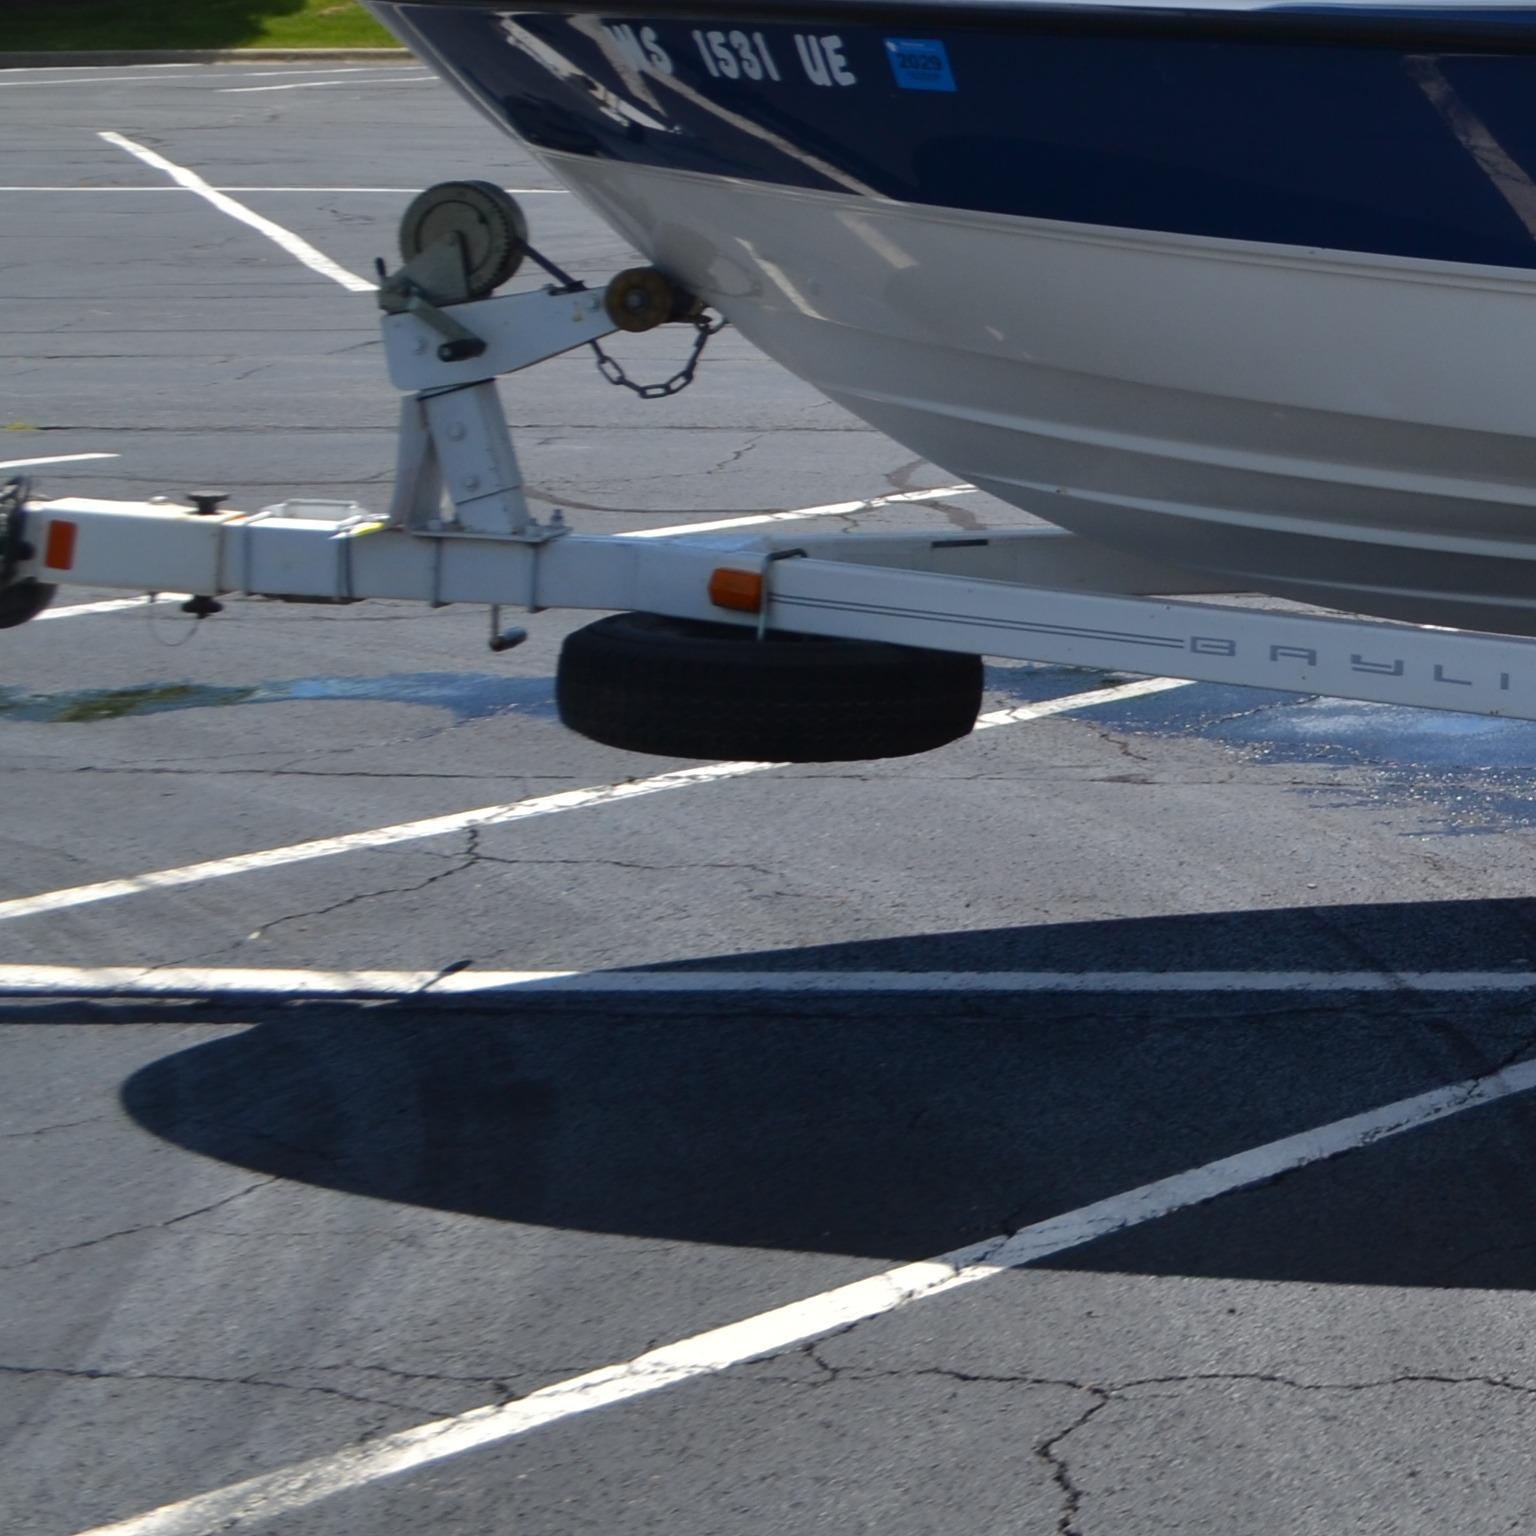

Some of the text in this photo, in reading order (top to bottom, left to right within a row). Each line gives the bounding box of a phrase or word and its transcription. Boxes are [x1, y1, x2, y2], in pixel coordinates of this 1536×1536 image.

[601, 23, 858, 88] WS 1531 UE
